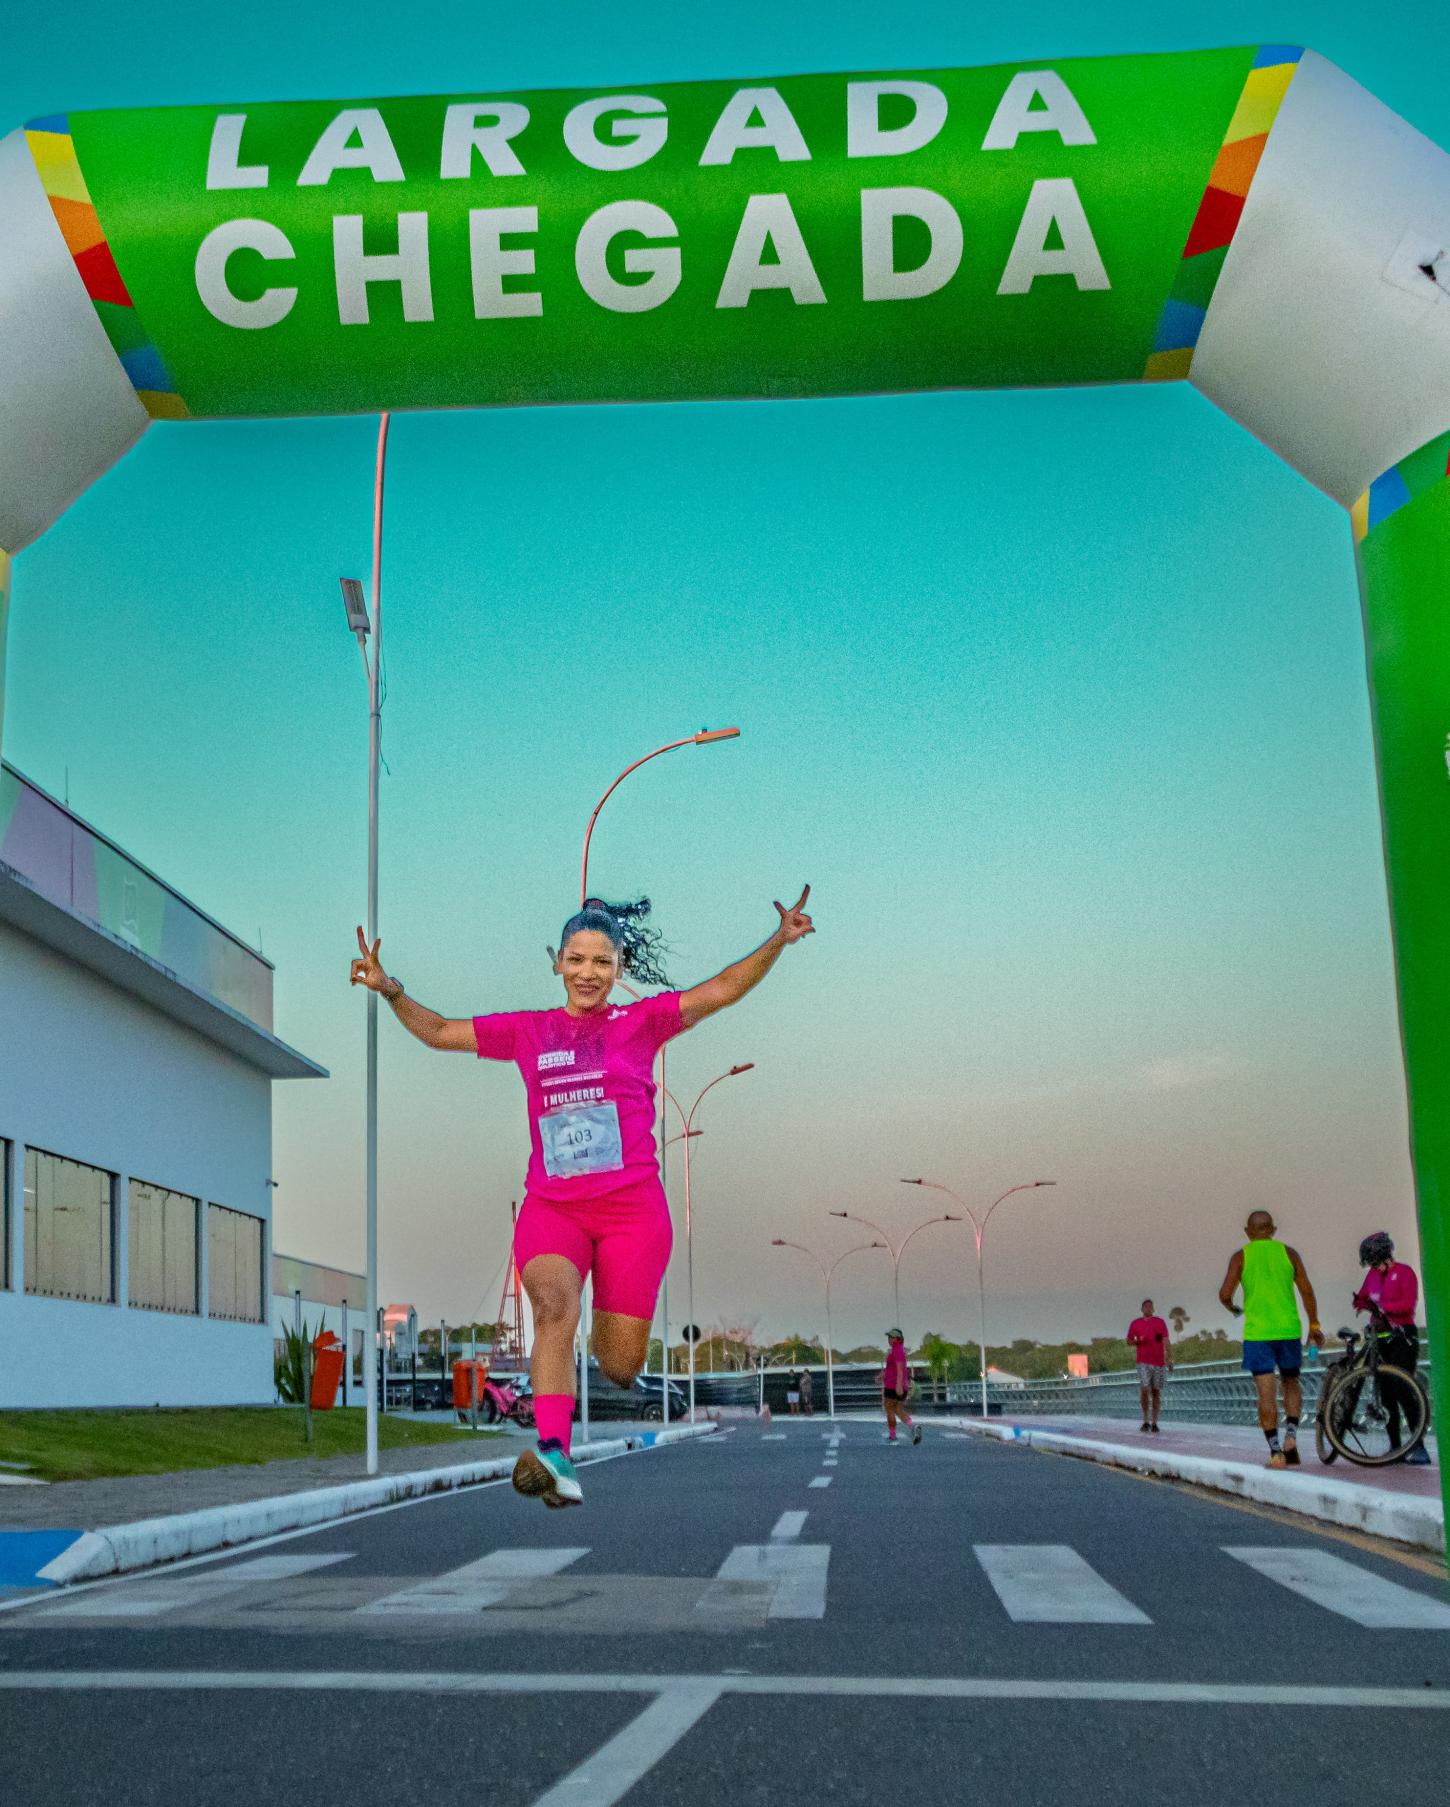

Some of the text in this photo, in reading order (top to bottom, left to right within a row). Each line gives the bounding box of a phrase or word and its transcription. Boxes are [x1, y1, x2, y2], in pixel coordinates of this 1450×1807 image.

[205, 70, 1098, 191] LARGADA
[194, 177, 1112, 330] CHEGADA
[568, 1129, 592, 1145] 103
